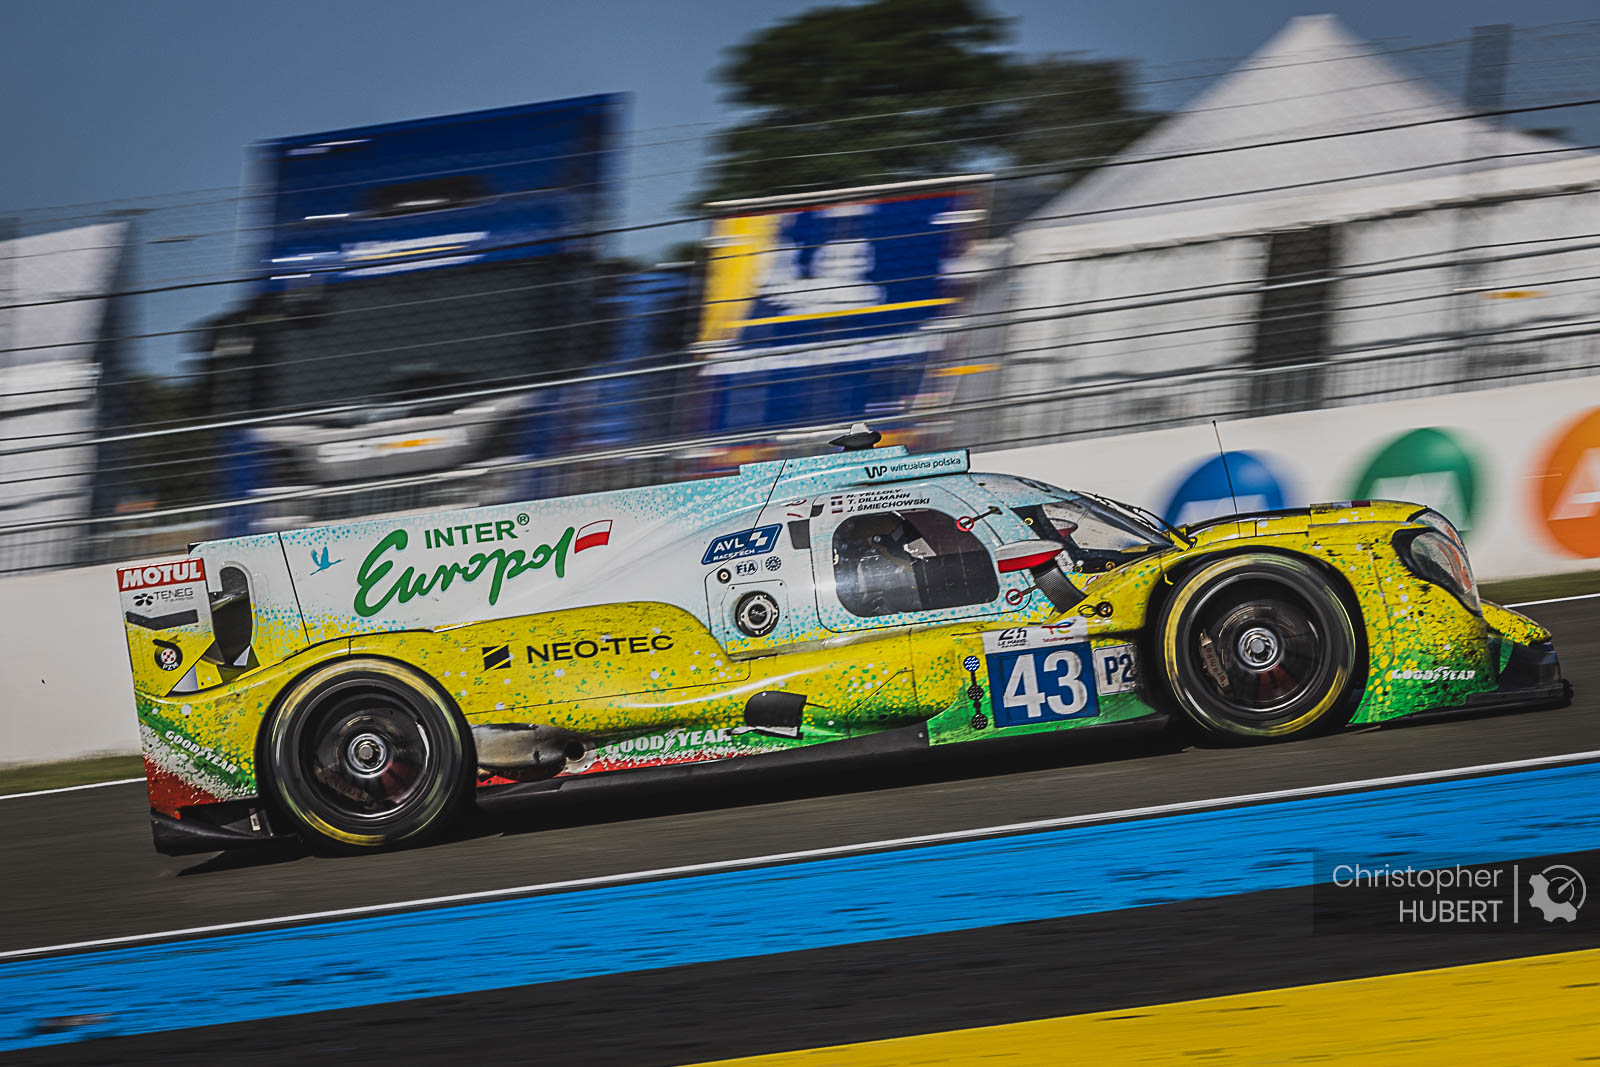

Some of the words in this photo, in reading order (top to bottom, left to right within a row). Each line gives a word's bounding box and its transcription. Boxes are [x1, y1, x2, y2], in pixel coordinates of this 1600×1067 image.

[890, 460, 931, 473] wirtualna
[933, 457, 961, 469] polska
[858, 493, 910, 504] DILLMANN
[713, 538, 745, 554] AVL
[122, 561, 202, 589] MOTUL
[353, 526, 575, 618] Europol
[736, 562, 756, 575] FIA
[153, 587, 194, 600] TENEG
[526, 635, 674, 664] NEO-TEC
[1104, 653, 1137, 686] P2
[1003, 650, 1088, 719] 43
